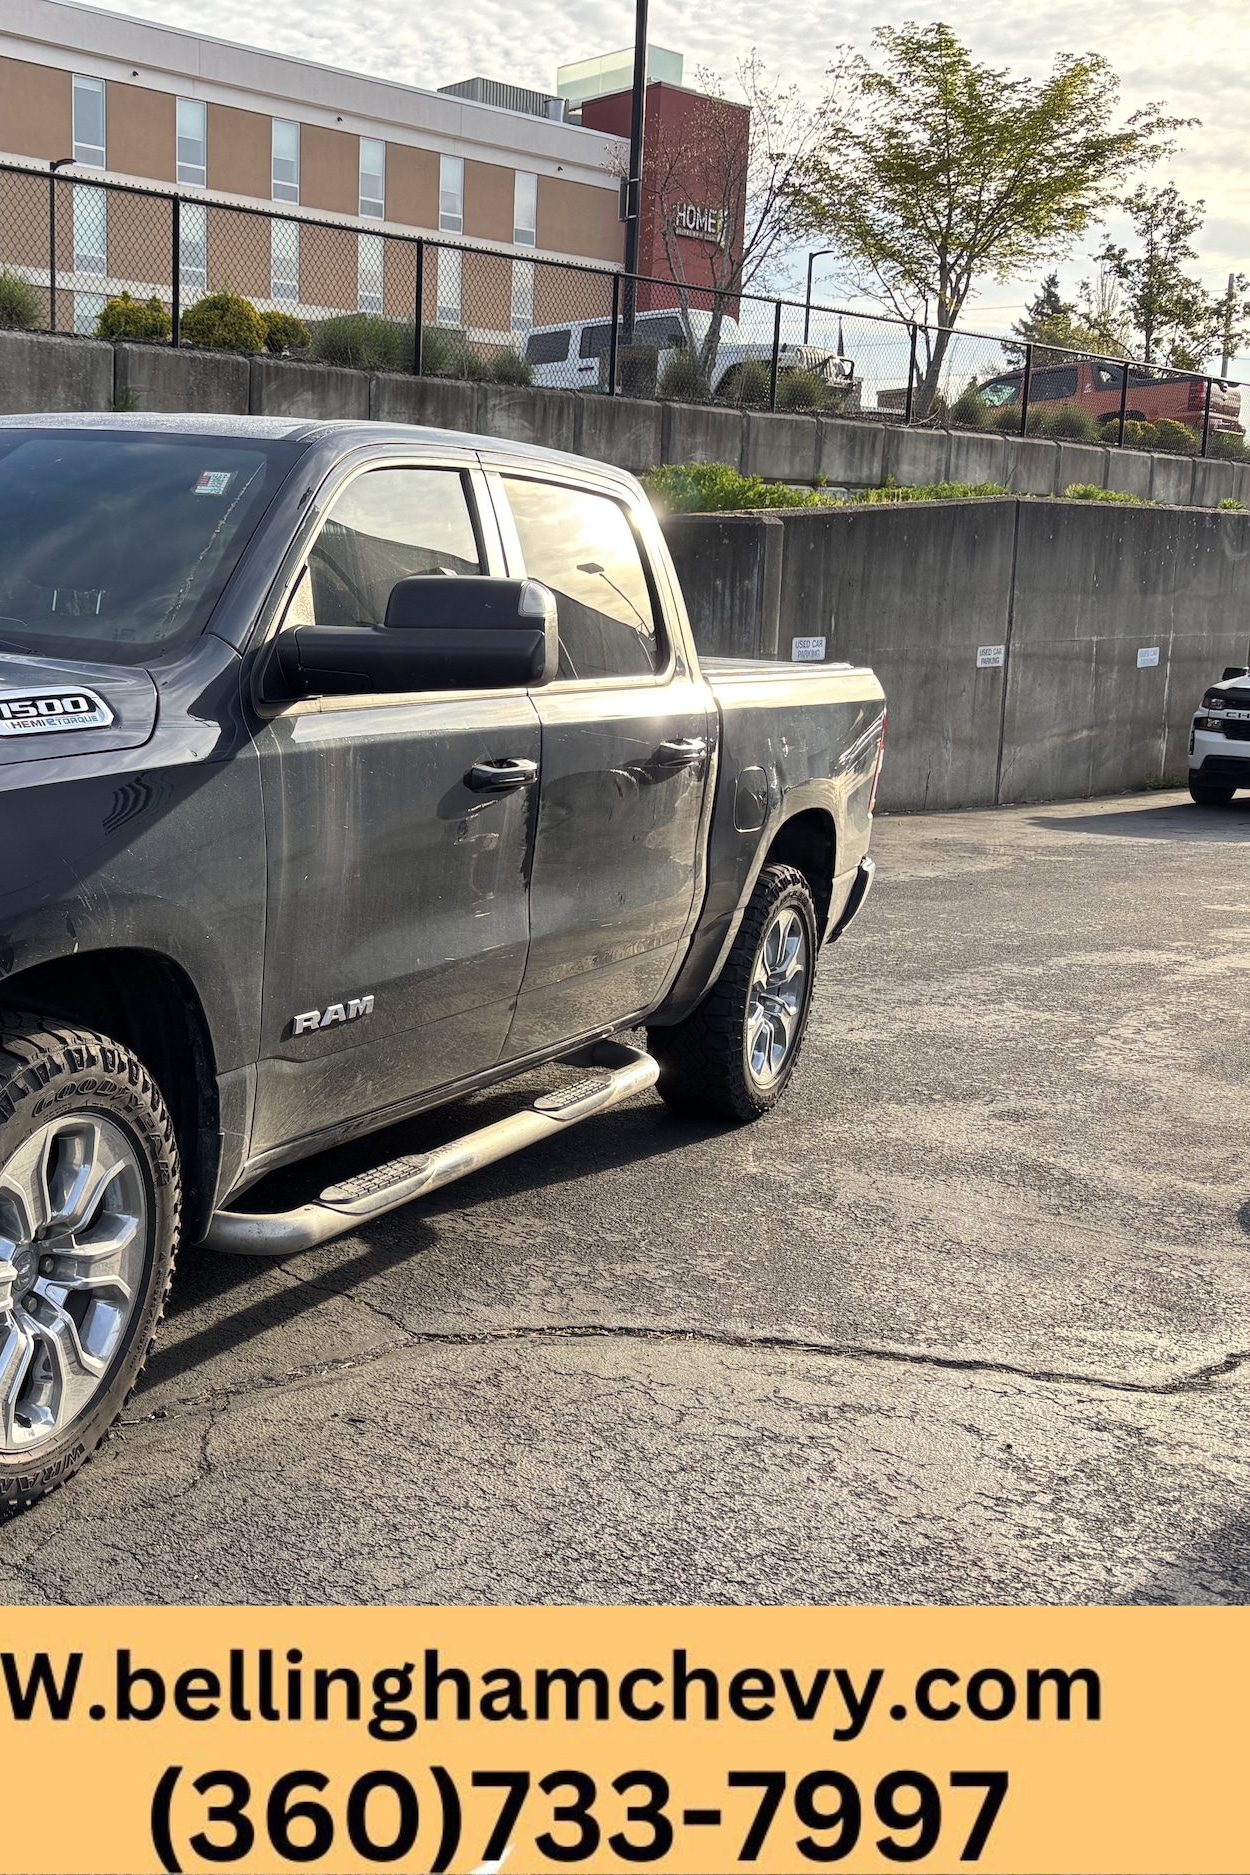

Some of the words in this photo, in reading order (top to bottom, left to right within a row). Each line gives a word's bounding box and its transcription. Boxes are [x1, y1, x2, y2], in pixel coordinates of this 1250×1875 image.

[795, 640, 810, 649] USED
[811, 639, 823, 648] CAR
[11, 718, 46, 730] HEMI
[293, 995, 374, 1035] RAM
[32, 1076, 171, 1188] GOODYEAR
